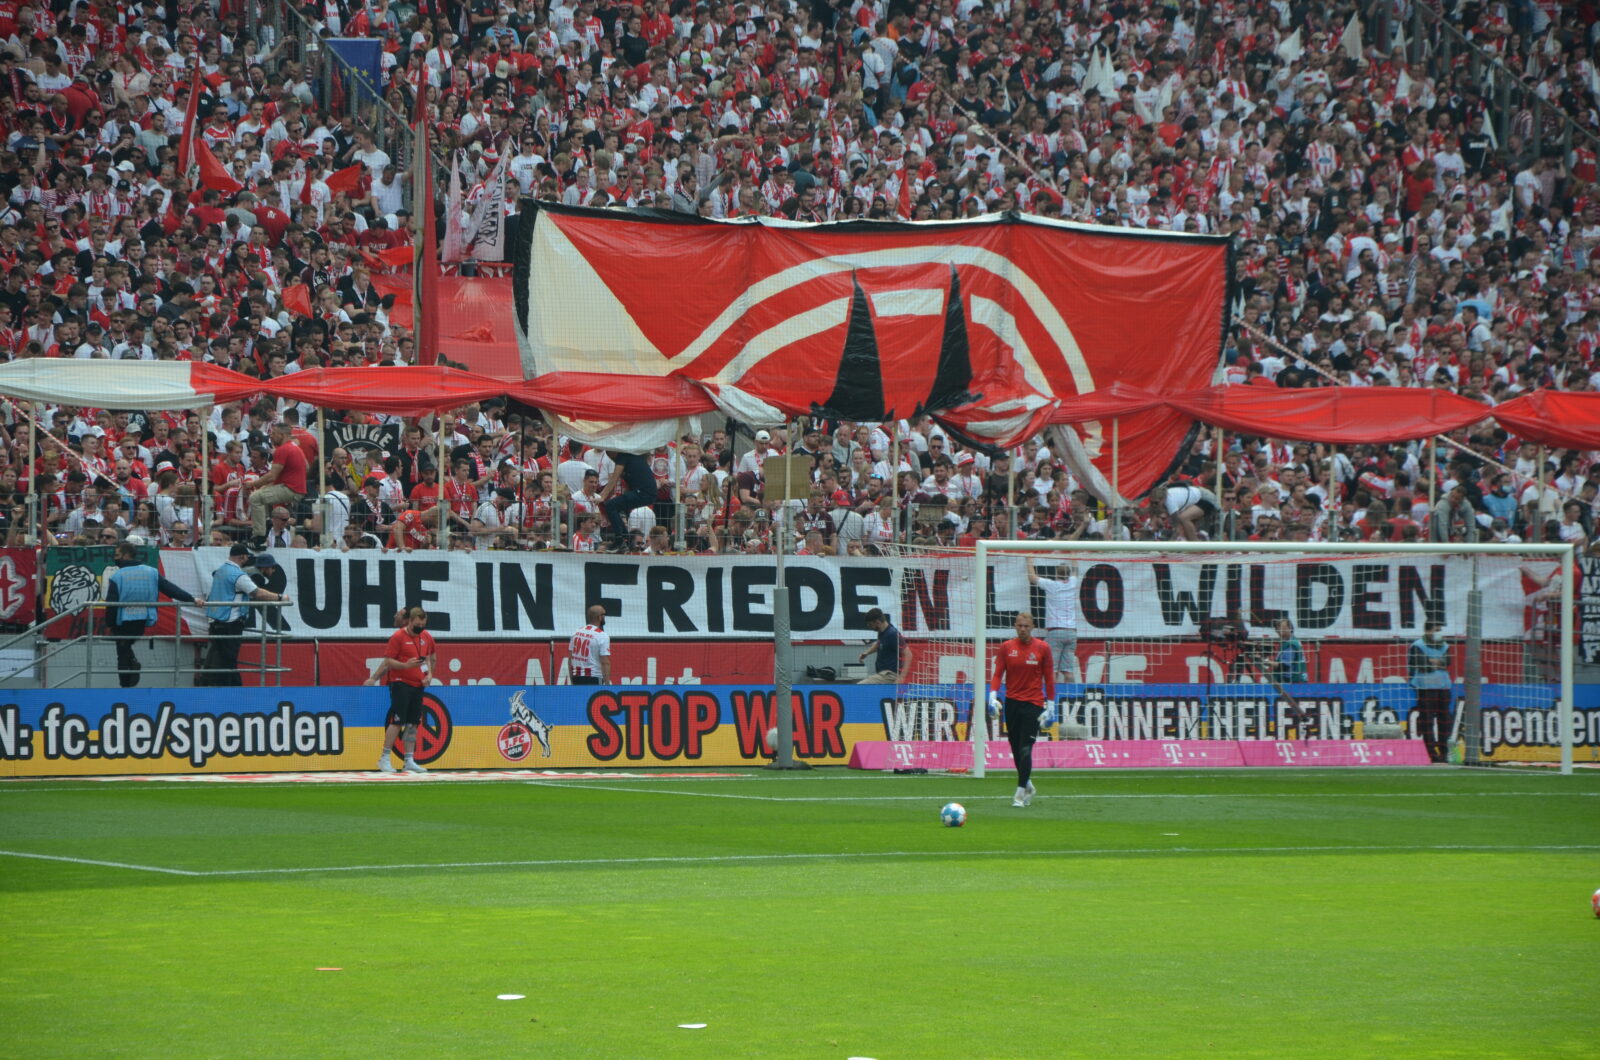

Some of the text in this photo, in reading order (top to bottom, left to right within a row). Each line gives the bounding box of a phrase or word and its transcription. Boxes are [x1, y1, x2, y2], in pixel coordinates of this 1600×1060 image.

[332, 424, 393, 449] JUNGE
[476, 562, 555, 631] IN
[584, 561, 951, 633] FRIEDEN
[1153, 563, 1445, 630] WILDEN
[44, 702, 340, 763] fc.de/spenden
[590, 693, 718, 758] STOP
[883, 702, 956, 741] WIR
[1062, 692, 1199, 741] KÖNNEN
